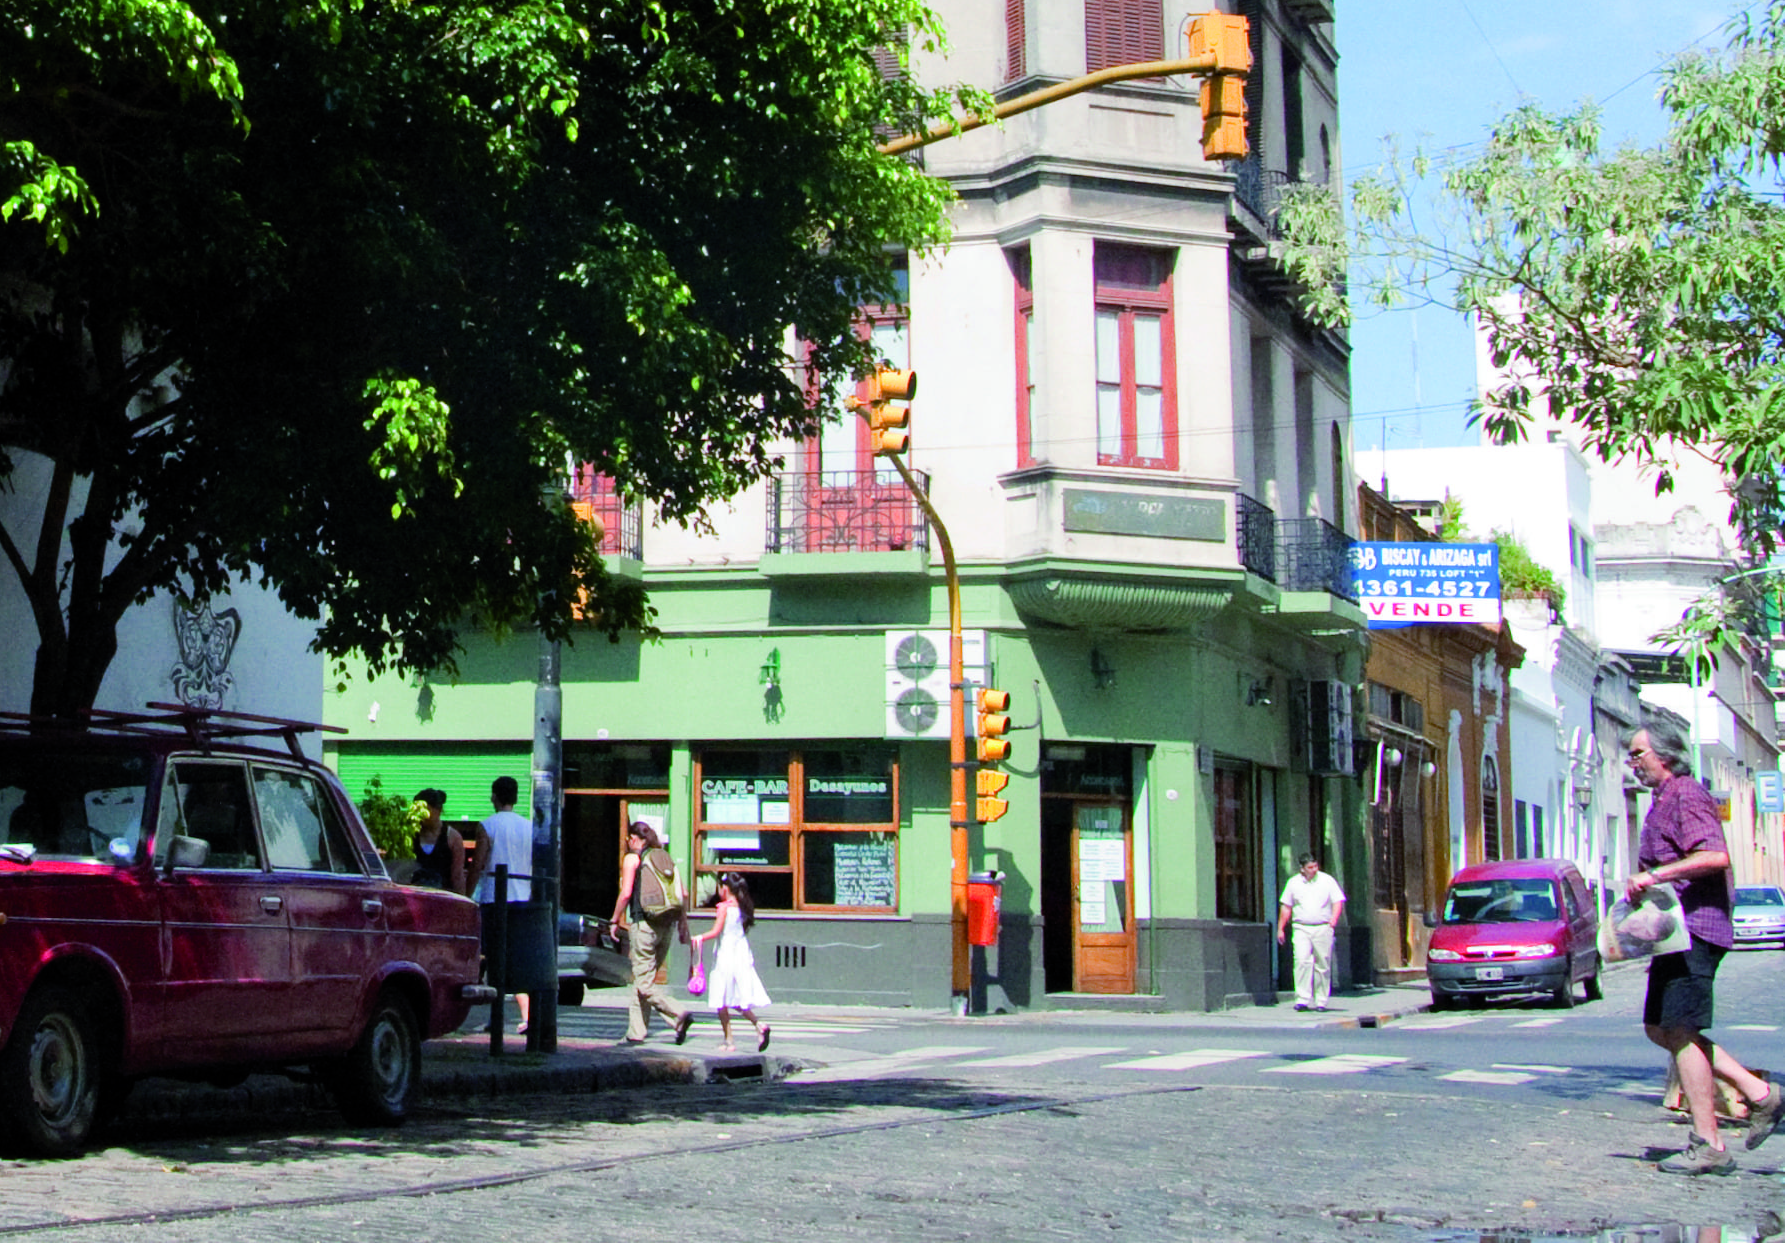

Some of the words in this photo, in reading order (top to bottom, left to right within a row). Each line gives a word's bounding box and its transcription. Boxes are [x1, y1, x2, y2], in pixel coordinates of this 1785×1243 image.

[1381, 548, 1420, 565] BISCAY
[1388, 568, 1417, 577] PERU
[1440, 569, 1466, 578] LOFT
[1369, 602, 1474, 616] VENDE
[809, 778, 887, 795] Desayunos
[1760, 776, 1779, 804] E
